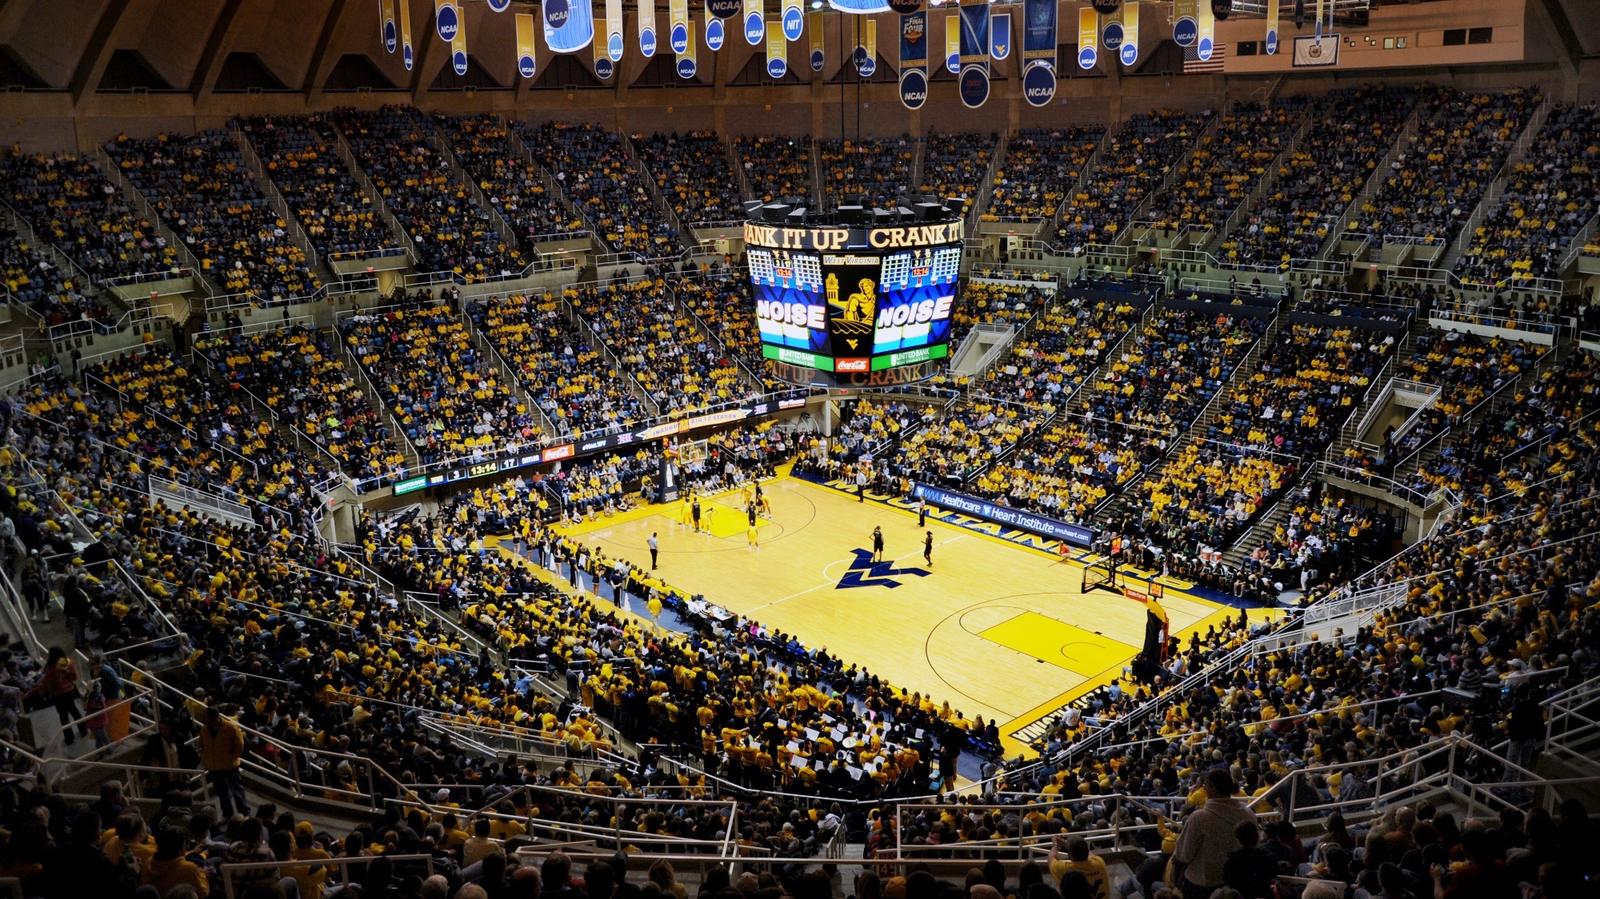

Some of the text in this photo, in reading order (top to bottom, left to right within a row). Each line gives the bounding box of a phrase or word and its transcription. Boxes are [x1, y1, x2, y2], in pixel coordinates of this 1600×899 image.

[712, 2, 740, 11] NCAA
[549, 11, 568, 21] NCAA
[441, 23, 457, 33] NCAA
[787, 20, 800, 30] NIT
[748, 30, 762, 38] NCAA
[1123, 50, 1135, 58] NIT
[905, 92, 926, 101] NCAA
[1028, 87, 1053, 97] NCAA
[782, 229, 806, 249] IT
[811, 229, 849, 250] UP
[869, 224, 947, 248] CRANK
[757, 300, 827, 331] NOISE
[877, 295, 955, 330] NOISE
[850, 363, 921, 386] CRANK
[471, 462, 497, 475] 13:14
[504, 459, 515, 468] 17
[941, 494, 981, 513] Healthcare
[991, 508, 1018, 524] Heart
[1016, 514, 1054, 533] Institute
